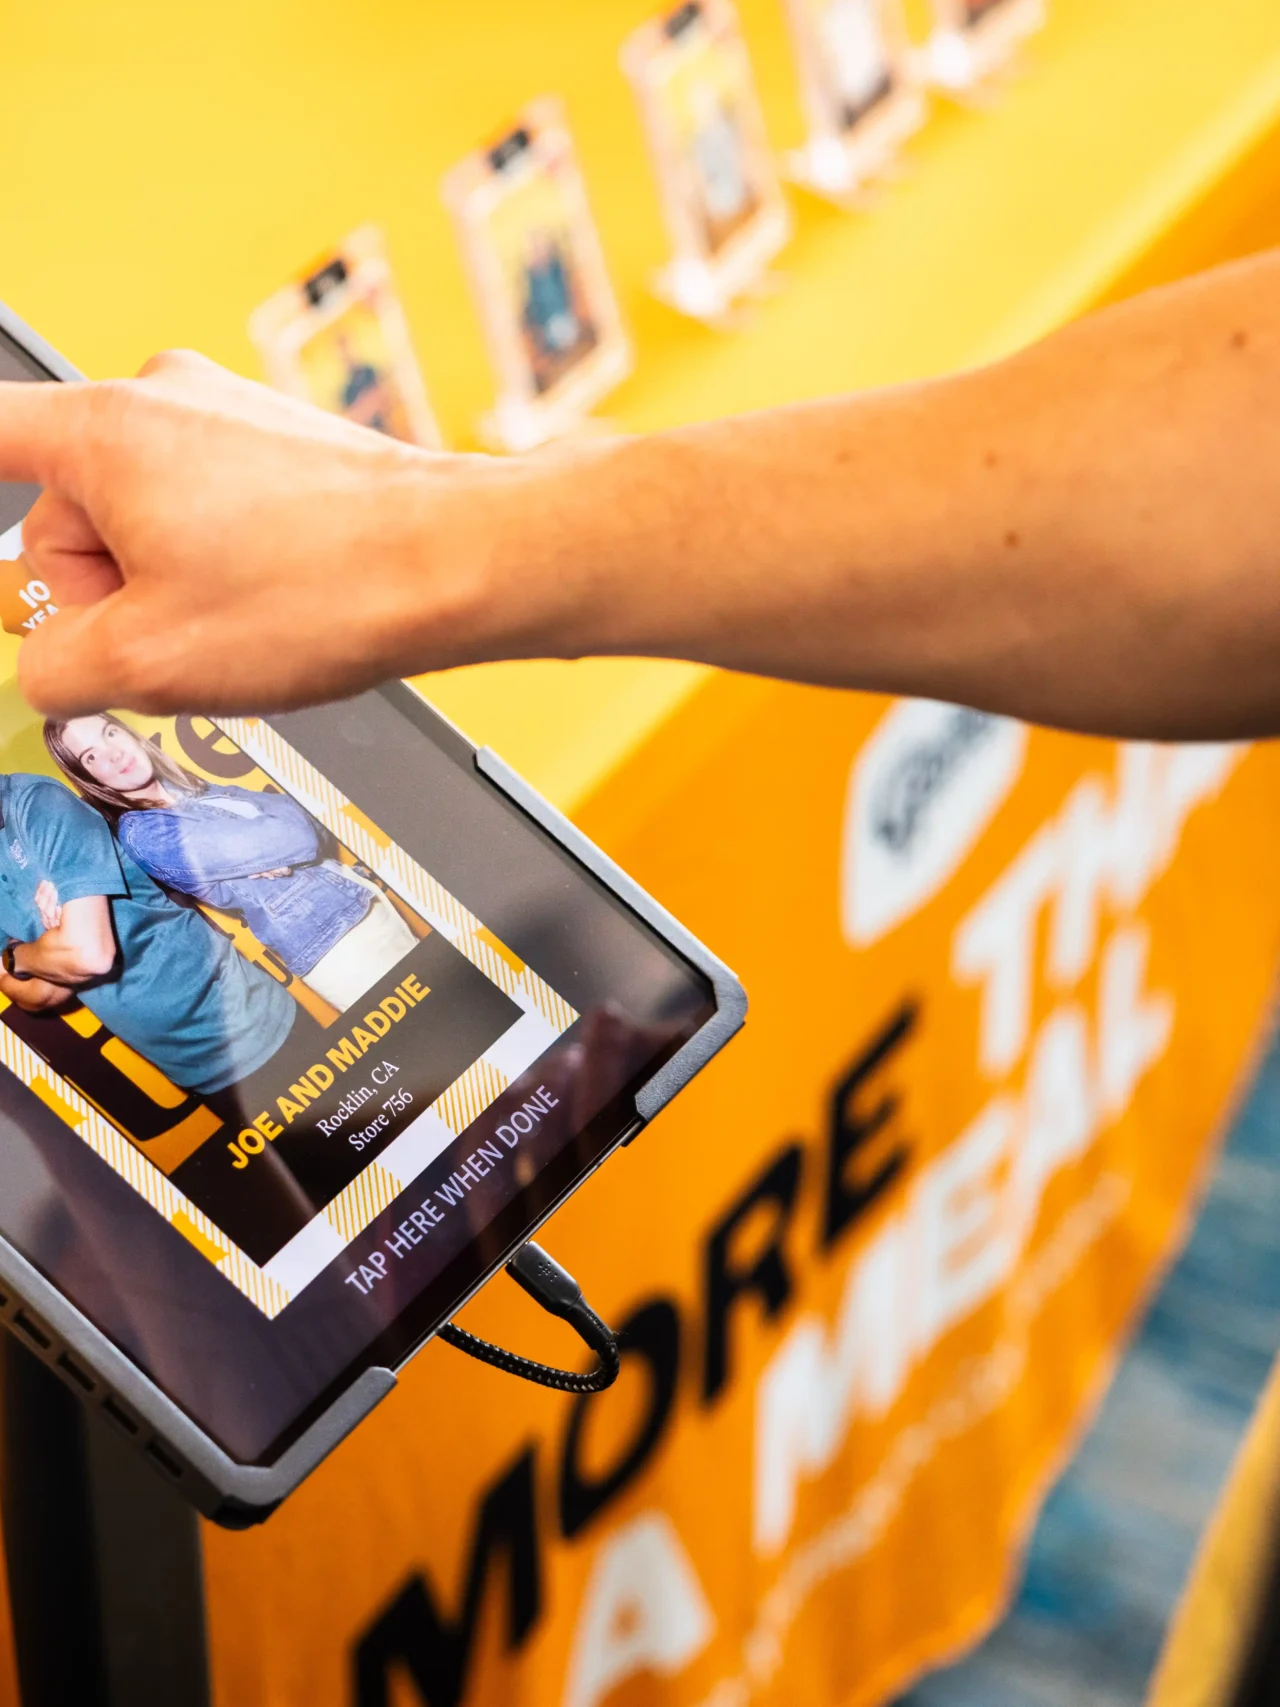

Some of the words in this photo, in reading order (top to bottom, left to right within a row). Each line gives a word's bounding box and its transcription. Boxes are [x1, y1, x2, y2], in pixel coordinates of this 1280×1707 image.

[18, 579, 52, 609] 10
[21, 603, 60, 631] YEA
[226, 1110, 285, 1170] JOE
[275, 1063, 336, 1125] AND
[325, 972, 432, 1074] MADDIE
[315, 1085, 380, 1139] Rocklin,
[370, 1059, 401, 1086] CA
[347, 1112, 391, 1153] Store
[381, 1086, 414, 1118] 756
[343, 1249, 389, 1296] TAP
[384, 1197, 446, 1260] HERE
[434, 1139, 505, 1207] WHEN
[494, 1084, 560, 1149] DONE
[348, 990, 926, 1707] MORE
[560, 1506, 718, 1707] A
[753, 922, 1174, 1560] MEAL
